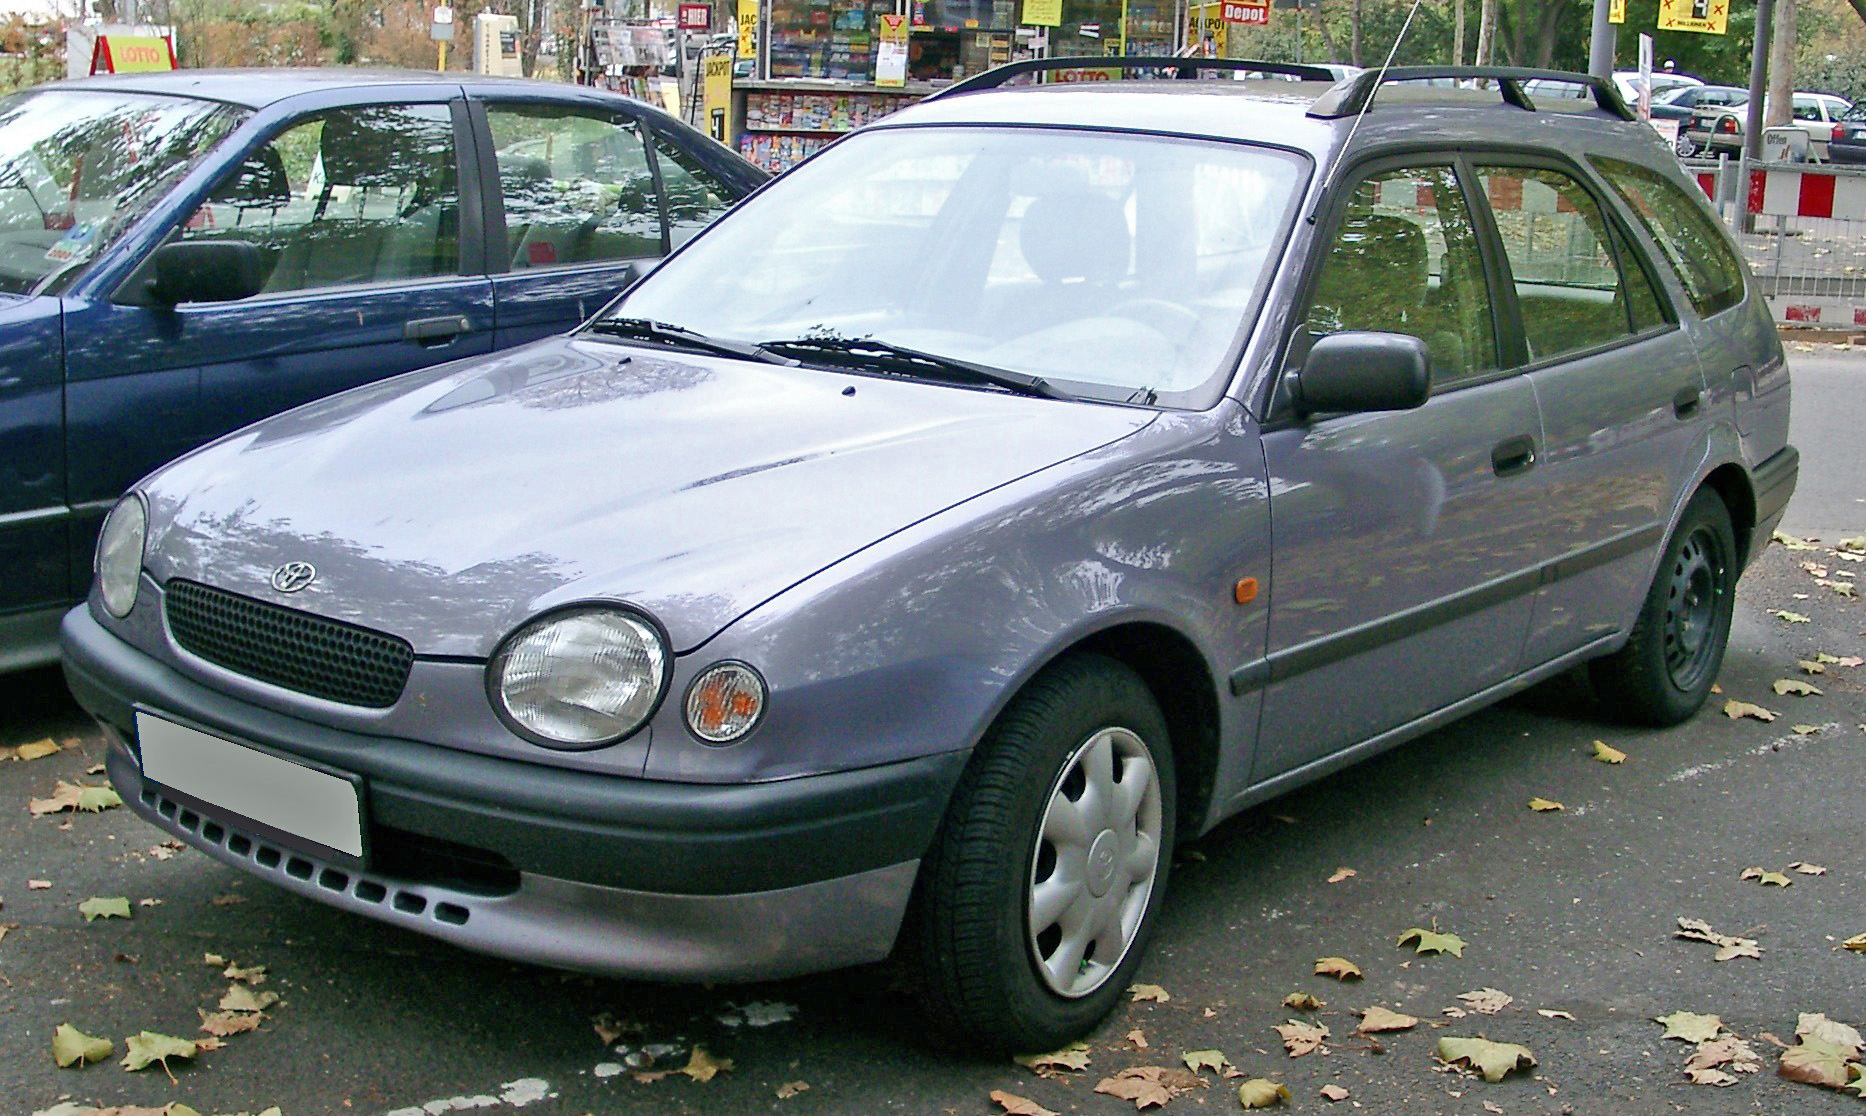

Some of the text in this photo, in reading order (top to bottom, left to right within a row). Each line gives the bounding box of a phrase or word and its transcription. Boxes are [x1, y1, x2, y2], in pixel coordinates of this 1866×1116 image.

[1225, 4, 1265, 21] Depot
[119, 46, 160, 64] LOTTO
[706, 60, 730, 77] JACKPOT
[1767, 134, 1787, 145] Offen
